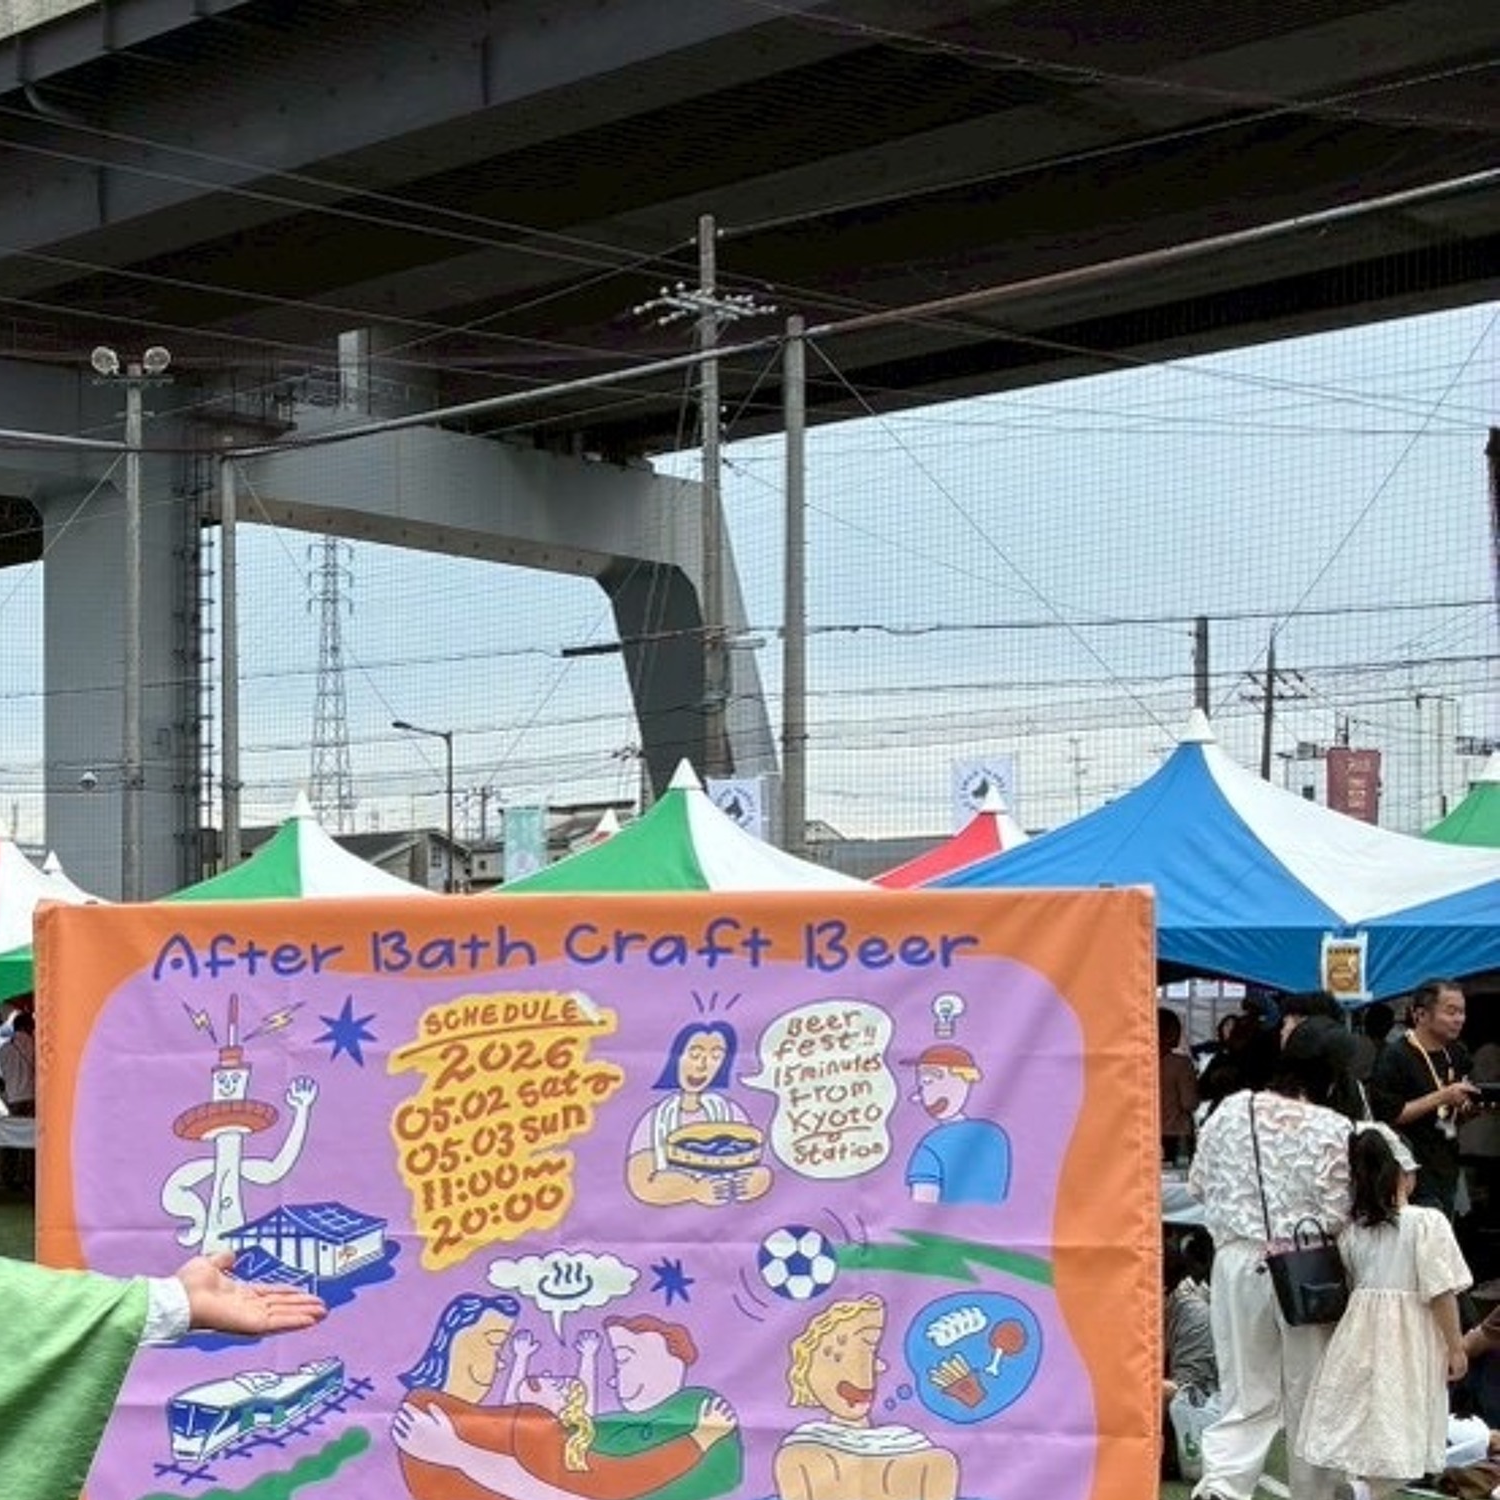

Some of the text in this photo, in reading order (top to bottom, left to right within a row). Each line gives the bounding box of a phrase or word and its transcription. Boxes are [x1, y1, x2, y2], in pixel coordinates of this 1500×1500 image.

[152, 917, 980, 981] After Bath Craft Beer
[425, 999, 579, 1036] SCHEDULE
[787, 1010, 862, 1037] Beer
[433, 1037, 580, 1090] 2026
[396, 1085, 510, 1142] 05.02
[405, 1121, 516, 1176] 05.03
[431, 1183, 565, 1255] 20:00
